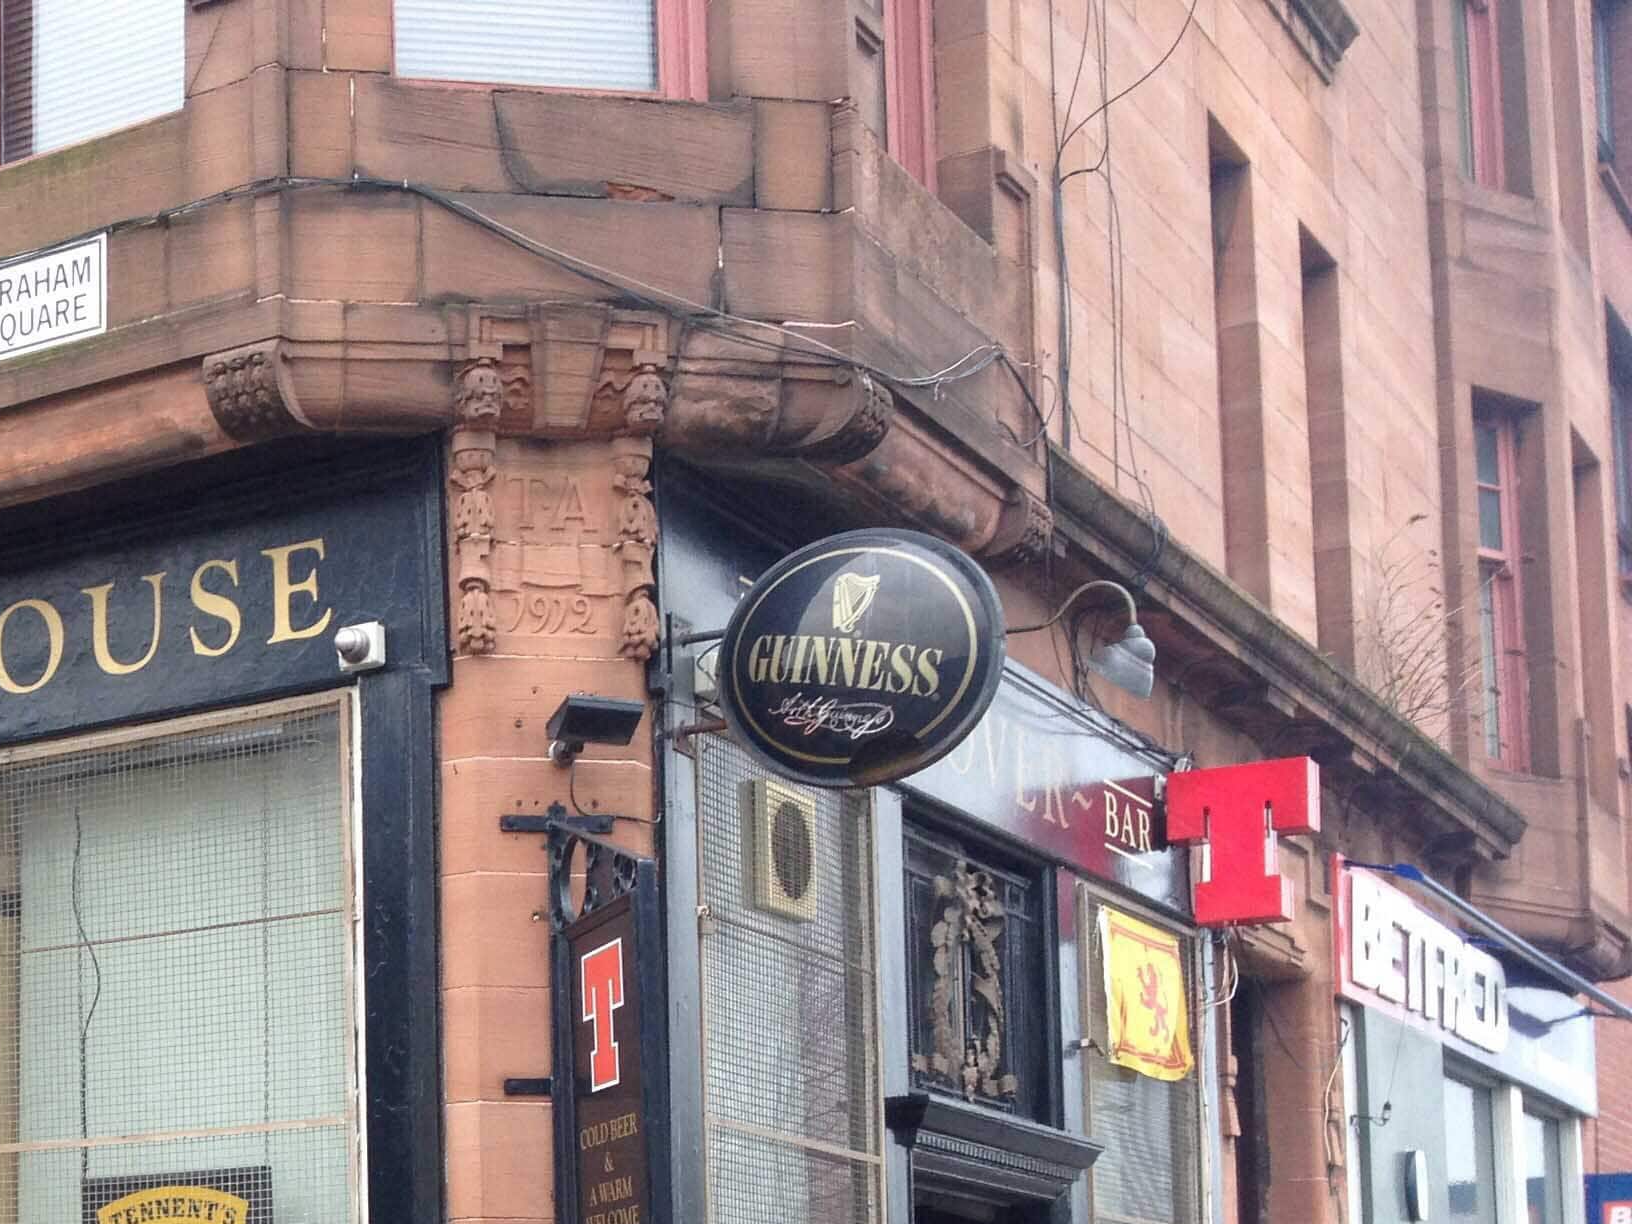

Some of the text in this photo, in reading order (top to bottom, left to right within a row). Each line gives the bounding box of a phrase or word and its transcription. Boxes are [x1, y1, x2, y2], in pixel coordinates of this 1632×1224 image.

[748, 634, 943, 698] GUINNESS
[1103, 789, 1153, 853] BAR
[1167, 755, 1321, 927] T
[1351, 866, 1509, 1055] BETFRED
[580, 937, 625, 1093] T
[579, 1111, 639, 1151] COLD BEER
[604, 1151, 615, 1173] &
[590, 1175, 633, 1207] A WARM
